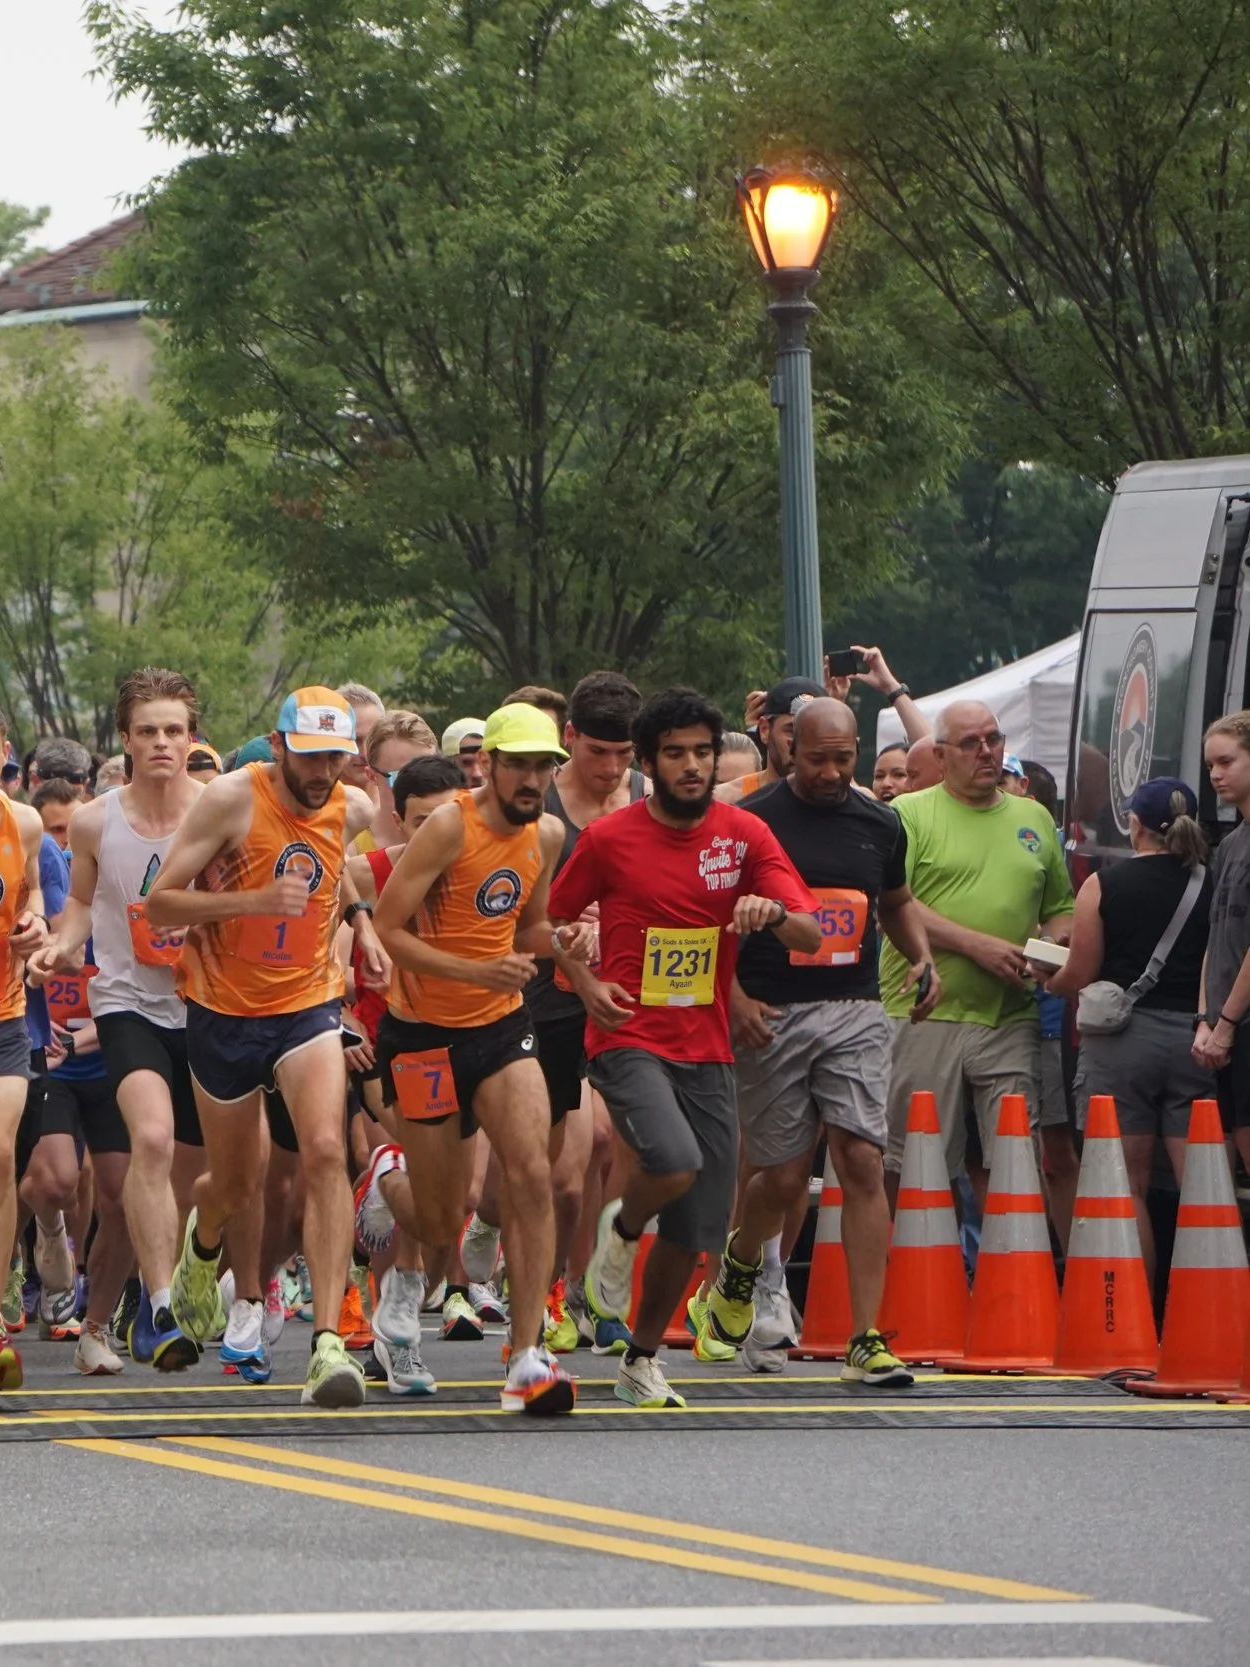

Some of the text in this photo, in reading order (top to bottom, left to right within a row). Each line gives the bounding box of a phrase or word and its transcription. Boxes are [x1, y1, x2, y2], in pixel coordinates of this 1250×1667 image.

[698, 848, 731, 877] Invite
[705, 873, 720, 890] TOP
[275, 920, 287, 949] 1
[649, 948, 712, 977] 1231
[49, 980, 81, 1006] 25
[670, 980, 693, 989] Ayaan
[423, 1071, 442, 1099] 7
[1104, 1271, 1115, 1333] MCRRC
